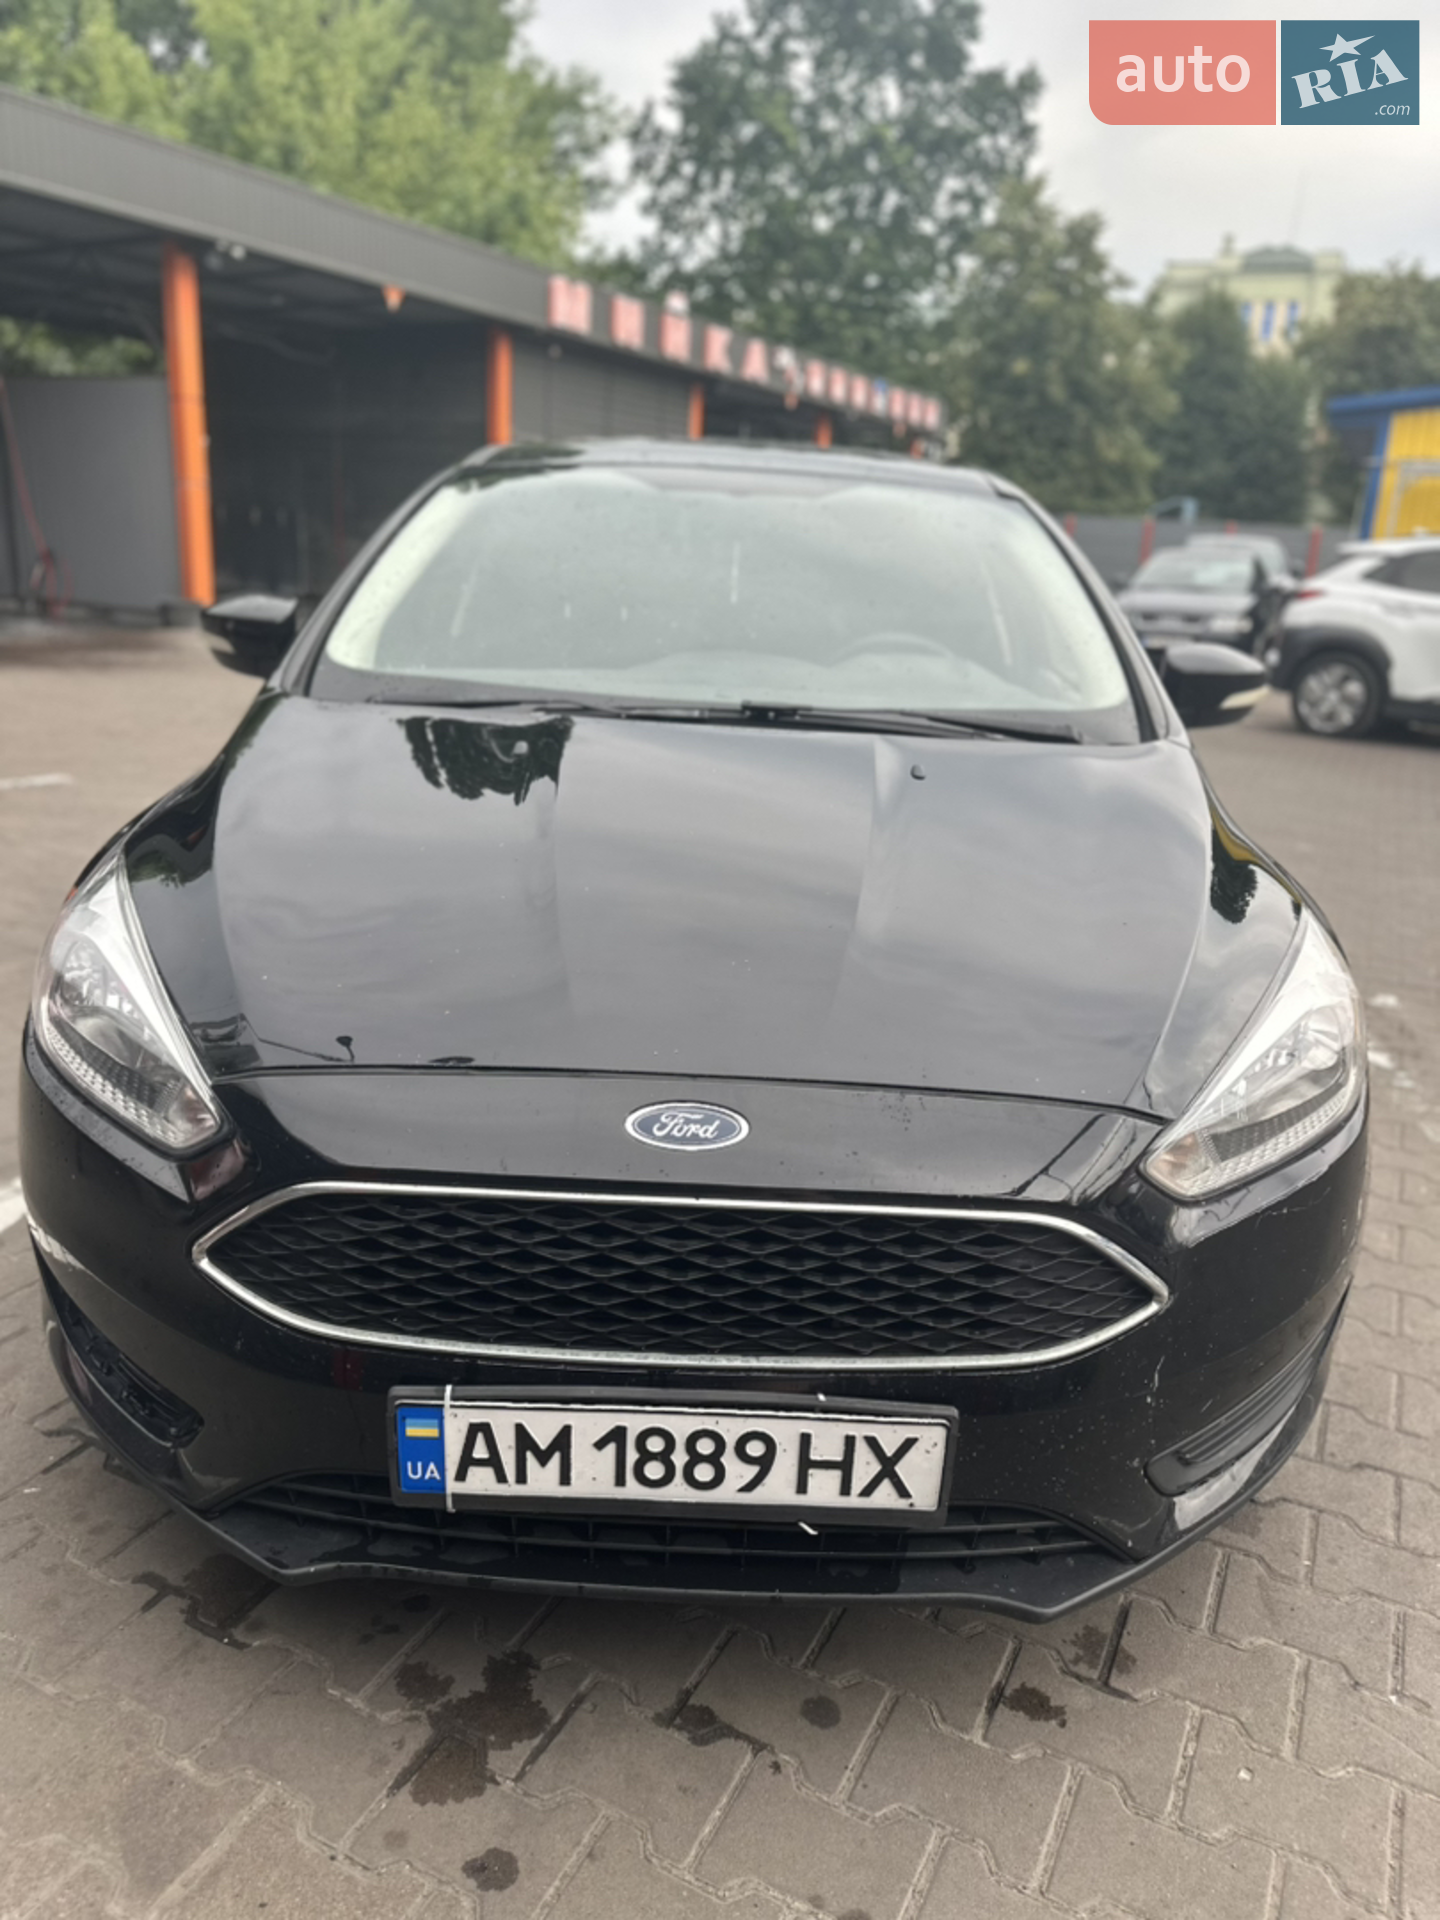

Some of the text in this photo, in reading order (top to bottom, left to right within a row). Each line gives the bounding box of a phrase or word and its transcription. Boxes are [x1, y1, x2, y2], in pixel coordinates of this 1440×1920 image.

[652, 1111, 721, 1139] Ford
[406, 1461, 442, 1481] UA
[453, 1421, 920, 1499] AM 1889 HX
